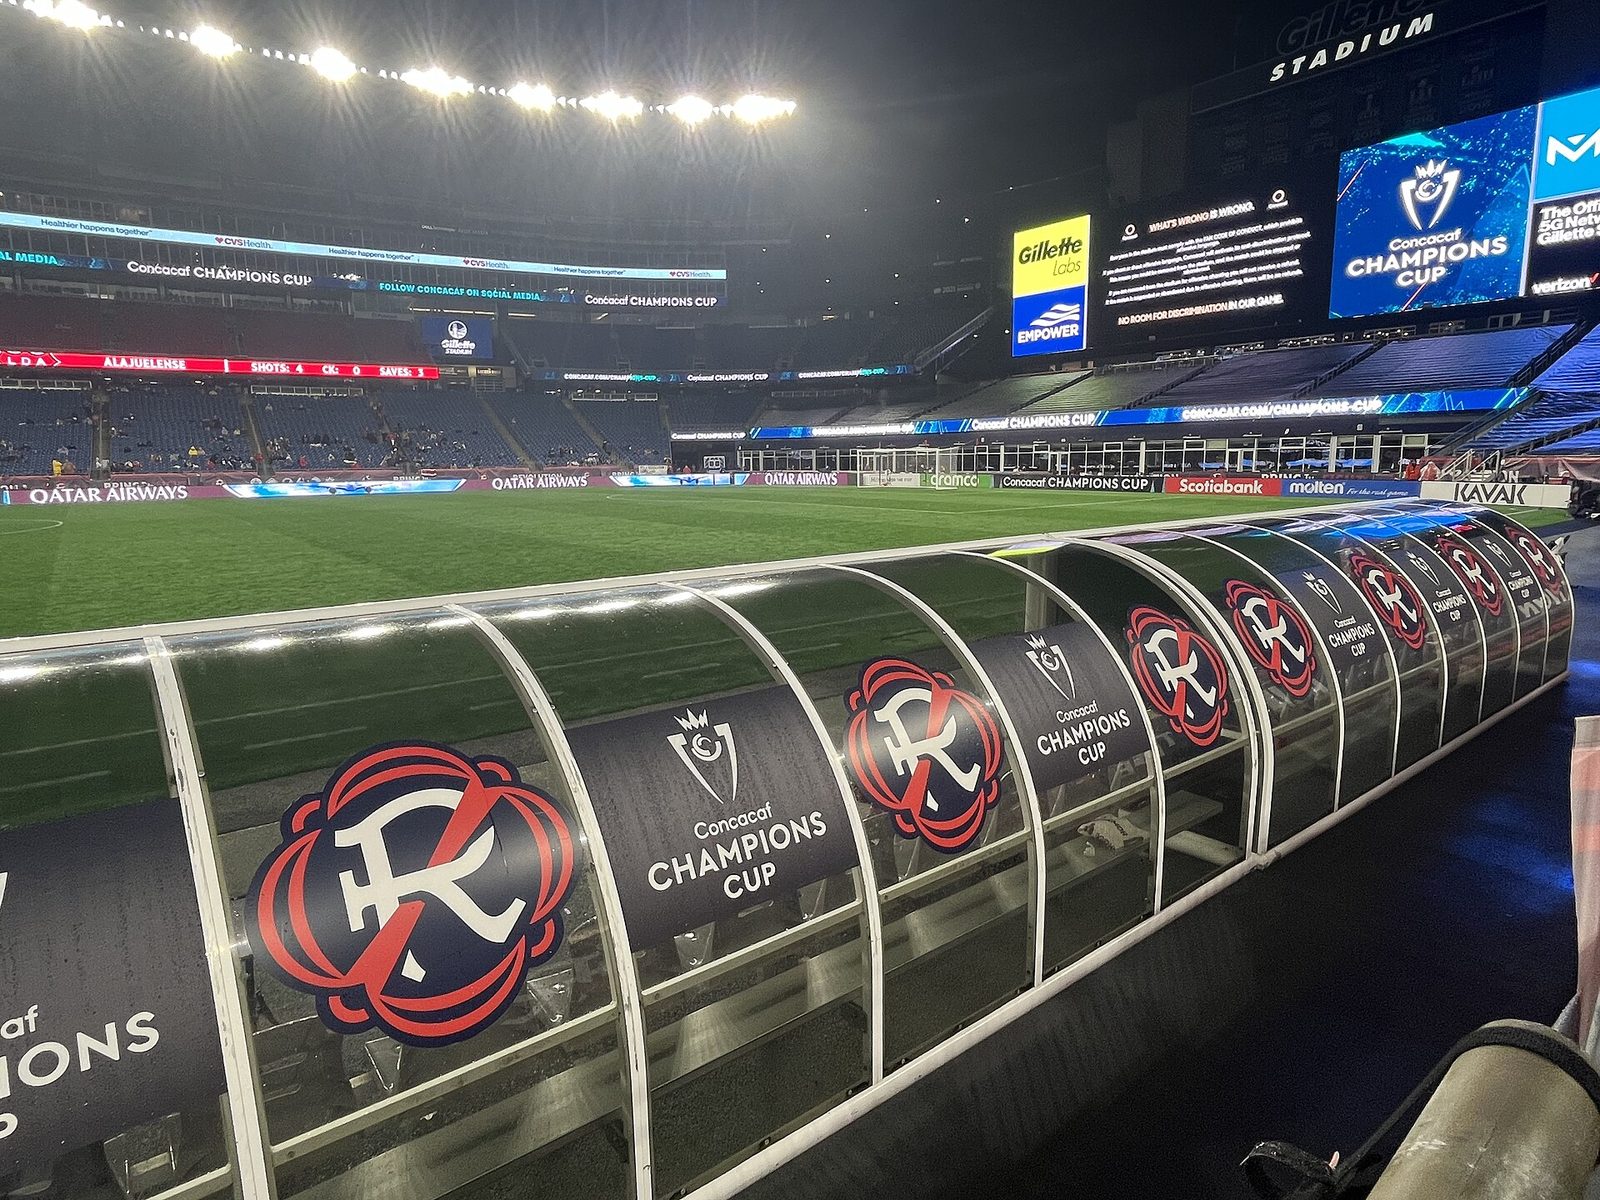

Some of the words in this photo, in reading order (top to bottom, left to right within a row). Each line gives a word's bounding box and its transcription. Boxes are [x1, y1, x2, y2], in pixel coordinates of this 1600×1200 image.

[1269, 13, 1433, 82] STADIUM
[1148, 219, 1178, 233] WHAT'S
[1178, 212, 1209, 226] WRONG
[1210, 209, 1218, 219] IS
[1218, 201, 1255, 218] WRONG.
[1540, 206, 1571, 220] The
[41, 218, 78, 229] Healthier
[80, 223, 115, 233] happens
[1538, 218, 1563, 233] 5G
[1389, 227, 1462, 251] Concacaf
[1537, 227, 1595, 245] Gillette
[15, 252, 58, 265] MEDIA
[329, 247, 357, 256] Healthier
[358, 250, 385, 259] happens
[1018, 236, 1083, 265] Gillette
[1346, 236, 1507, 277] CHAMPIONS
[127, 260, 191, 277] Concacaf
[193, 266, 281, 284] CHAMPIONS
[283, 273, 312, 286] CUP
[1053, 257, 1081, 276] Labs
[1396, 266, 1446, 287] CUP
[1531, 277, 1591, 294] verizon
[379, 282, 416, 293] FOLLOW
[417, 285, 465, 296] CONCACAF
[466, 288, 479, 297] ON
[480, 289, 511, 299] SOCIAL
[513, 291, 541, 301] MEDIA
[585, 294, 629, 306] Concacaf
[630, 296, 693, 307] CHAMPIONS
[694, 297, 717, 307] CUP
[1017, 323, 1079, 344] EMPOWER
[104, 357, 186, 369] ALAJUELENSE
[251, 363, 290, 373] SHOTS:
[295, 364, 303, 373] 4
[322, 365, 339, 374] CK:
[353, 366, 360, 374] 0
[379, 367, 412, 377] SAVES:
[1010, 416, 1070, 429] CHAMPIONS
[1071, 414, 1094, 426] CUP
[491, 475, 533, 491] QATAR
[536, 474, 588, 488] AIRWAYS
[765, 472, 796, 485] QATAR
[796, 472, 838, 485] AIRWAYS
[1003, 476, 1047, 488] Concacaf
[1047, 476, 1119, 489] CHAMPIONS
[1121, 478, 1149, 490] CUP
[1179, 478, 1263, 495] Scotiabank
[1290, 480, 1339, 495] molten
[29, 487, 101, 504] QATAR
[106, 485, 188, 501] AIRWAYS
[1454, 483, 1528, 505] KAVAK
[1328, 622, 1376, 648] CHAMPIONS
[1350, 642, 1366, 657] CUP
[1056, 700, 1099, 723] Concacaf
[1037, 708, 1131, 756] CHAMPIONS
[1078, 741, 1106, 765] CUP
[693, 801, 773, 840] Concacaf
[647, 811, 827, 891] CHAMPIONS
[723, 862, 776, 899] CUP
